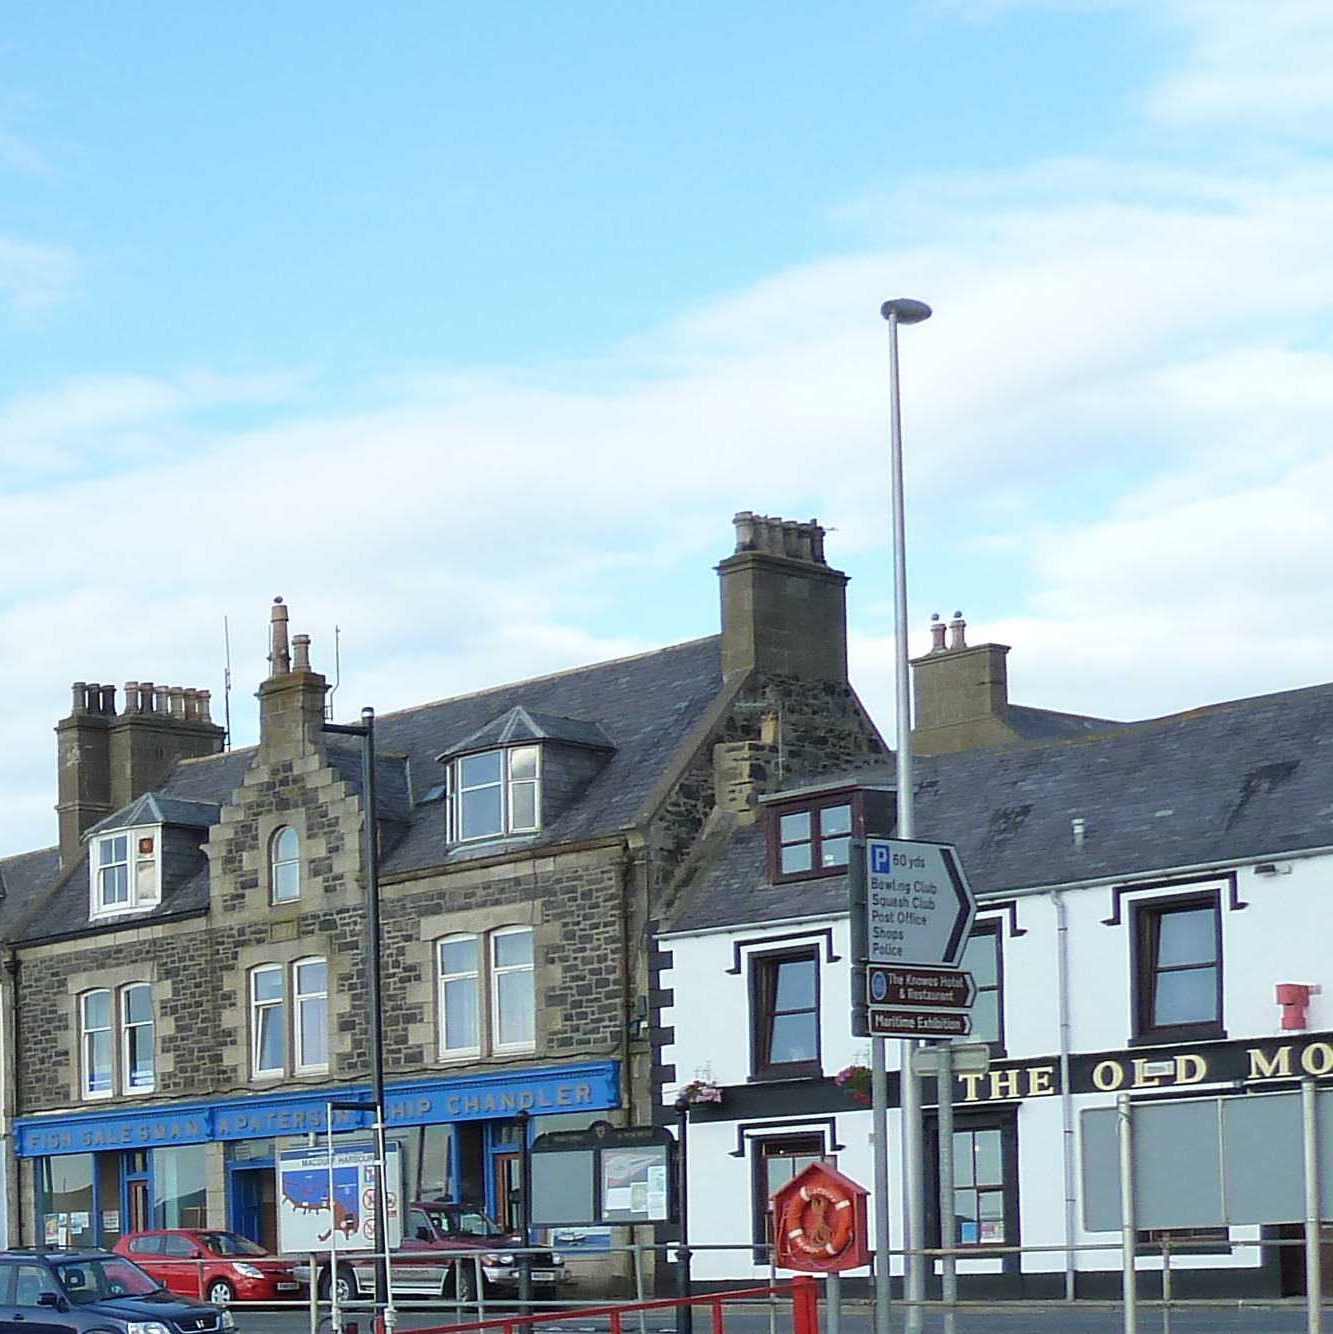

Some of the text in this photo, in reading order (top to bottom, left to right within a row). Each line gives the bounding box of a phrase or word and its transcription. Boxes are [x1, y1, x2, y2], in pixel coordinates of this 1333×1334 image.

[909, 855, 925, 869] yds
[871, 877, 937, 894] Bowling Club
[872, 894, 935, 910] Squash Club
[872, 910, 927, 925] Post Office
[873, 926, 904, 941] Shops
[873, 942, 902, 956] Police
[888, 973, 903, 985] The
[940, 976, 964, 988] Hotel
[907, 989, 954, 1001] Restaurant
[875, 1014, 961, 1030] Maritime Exhibition
[958, 1066, 1054, 1101] THE
[1092, 1054, 1207, 1091] OLD
[447, 1083, 593, 1116] CHANDLER
[29, 1119, 201, 1150] FISH SALESMAN
